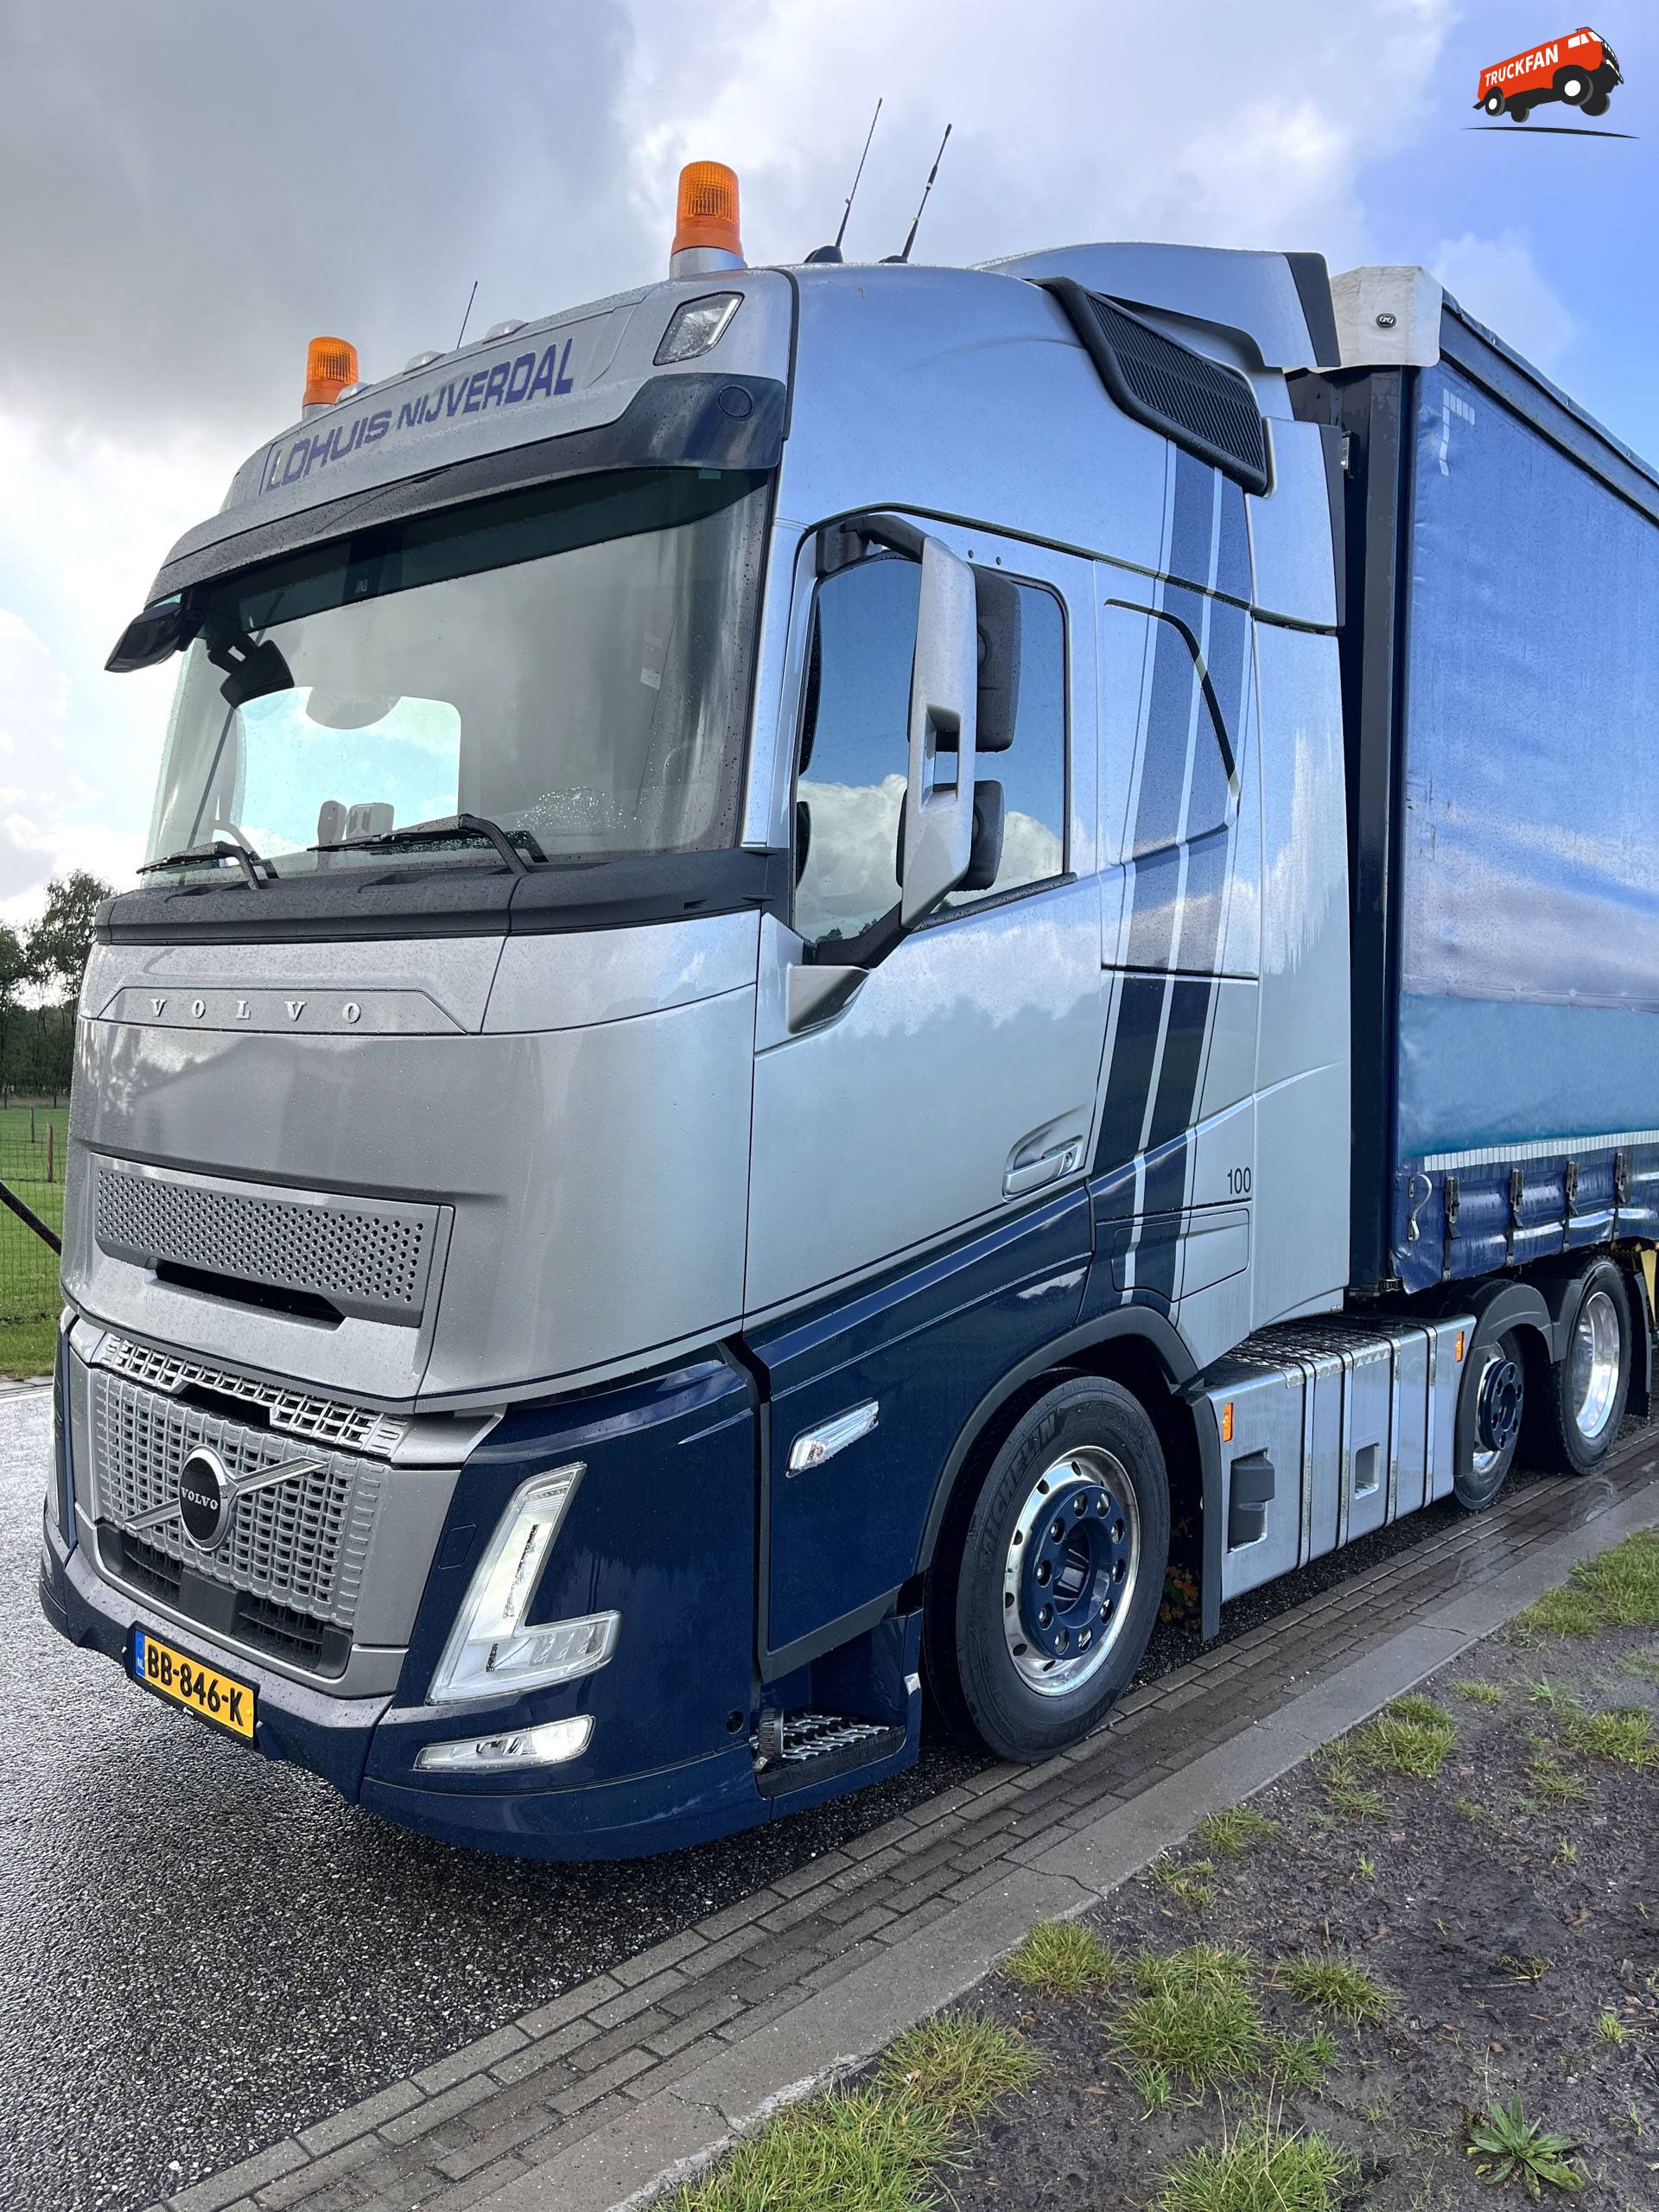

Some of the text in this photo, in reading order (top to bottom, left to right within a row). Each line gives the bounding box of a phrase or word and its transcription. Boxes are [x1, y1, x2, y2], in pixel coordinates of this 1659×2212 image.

[264, 337, 574, 492] LOHUIS NIJVERDAL
[149, 998, 361, 1025] VOLVO
[1227, 1166, 1251, 1194] 100
[181, 1486, 219, 1510] VOLVO
[148, 1644, 244, 1727] BB-846-K
